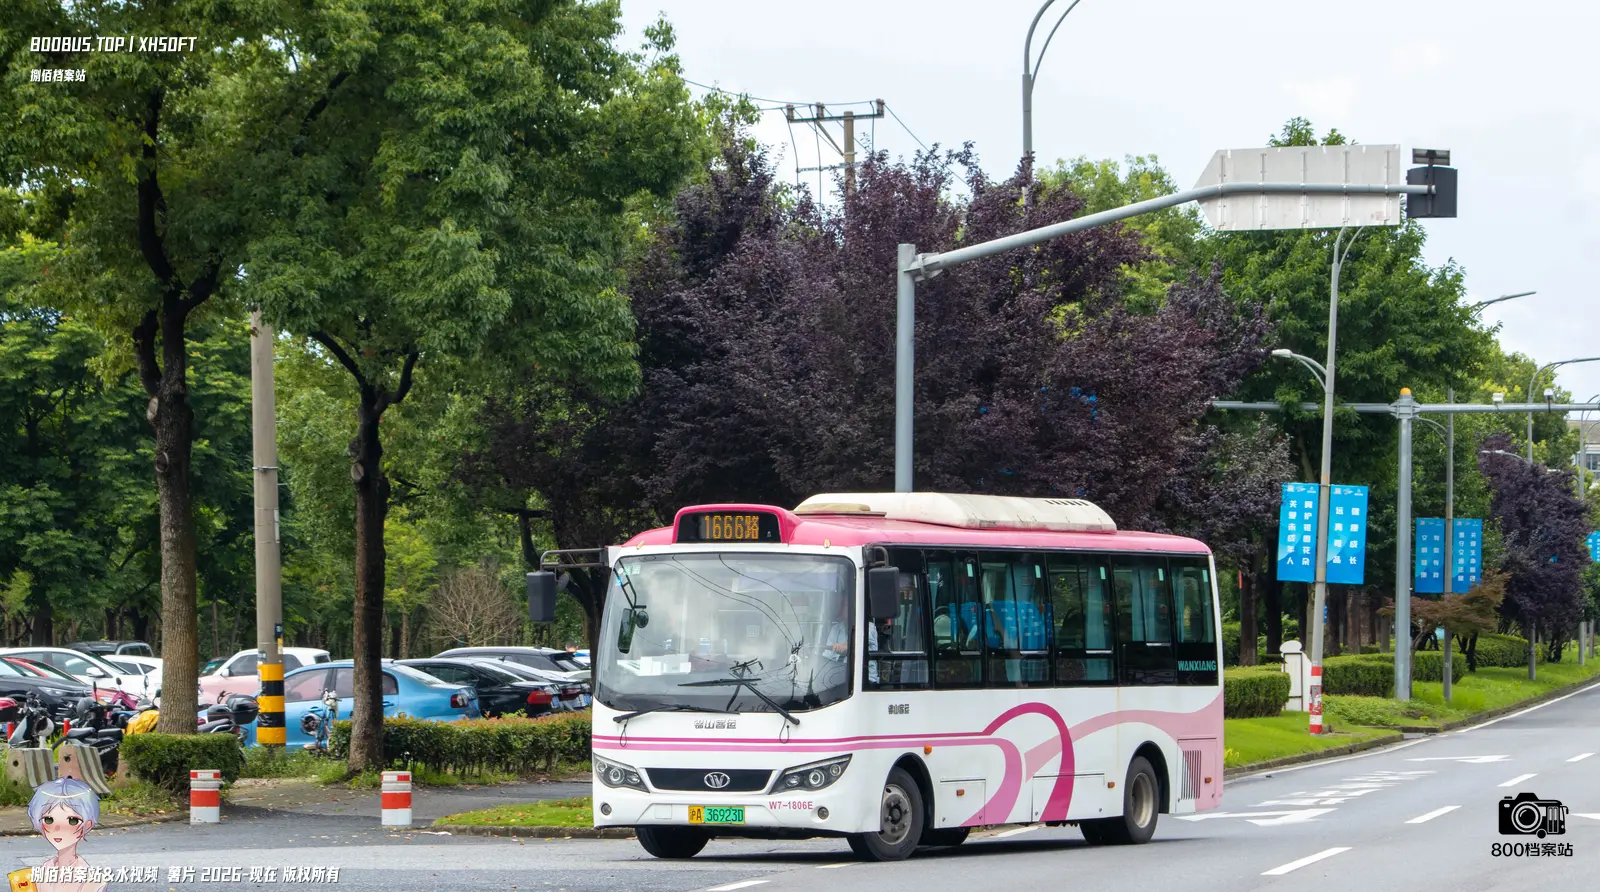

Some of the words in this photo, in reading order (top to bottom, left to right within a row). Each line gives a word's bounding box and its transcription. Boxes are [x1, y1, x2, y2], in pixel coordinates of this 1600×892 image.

[704, 515, 760, 540] 1666路
[1177, 660, 1217, 671] WANXIANG
[769, 801, 813, 810] W7-1806E
